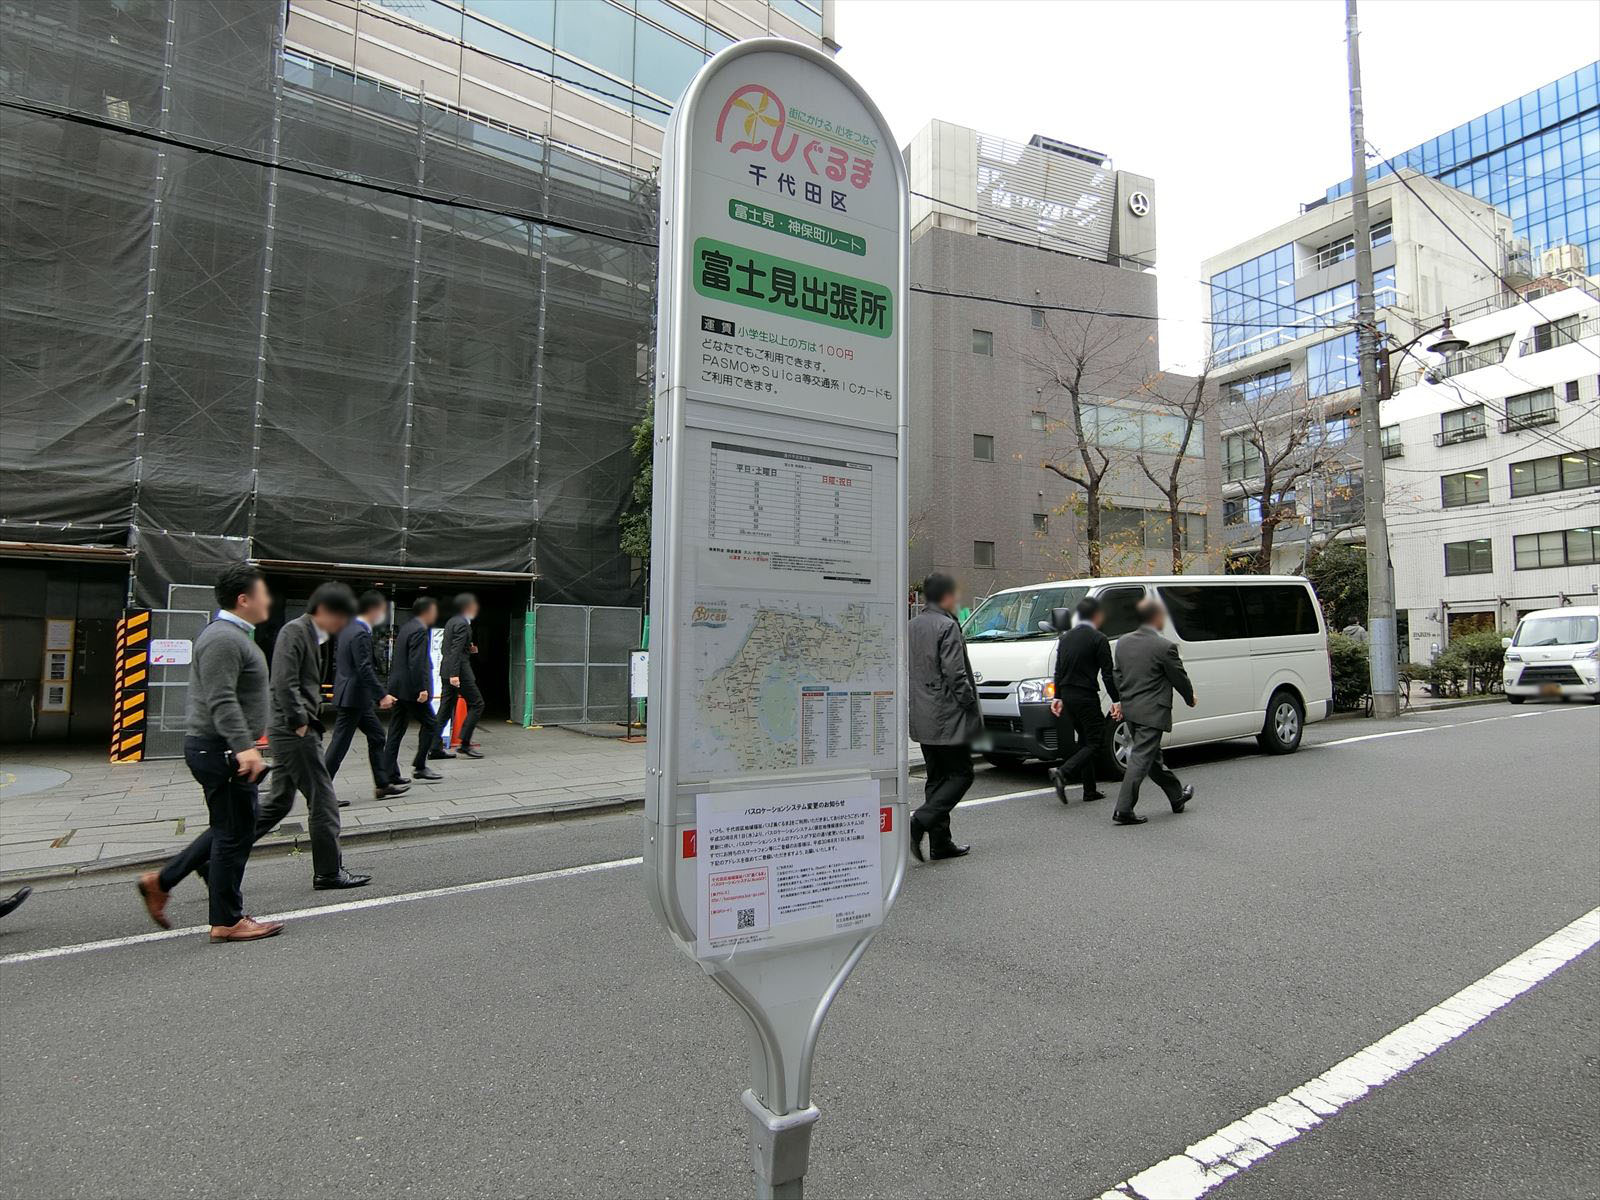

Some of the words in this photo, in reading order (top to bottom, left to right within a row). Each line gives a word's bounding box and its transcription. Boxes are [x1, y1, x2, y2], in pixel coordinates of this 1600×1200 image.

[748, 163, 847, 212] 千代田区
[734, 203, 862, 252] 富士見・神保町ルート
[701, 250, 887, 330] 富士見出張所
[701, 338, 828, 373] どなたでもご利用できます。
[701, 370, 780, 396] ご利用できます。
[736, 463, 777, 477] 平日・土曜日
[822, 475, 852, 487] 日曜・祝日
[744, 799, 846, 816] バスロケーションシステム変更のお知らせ
